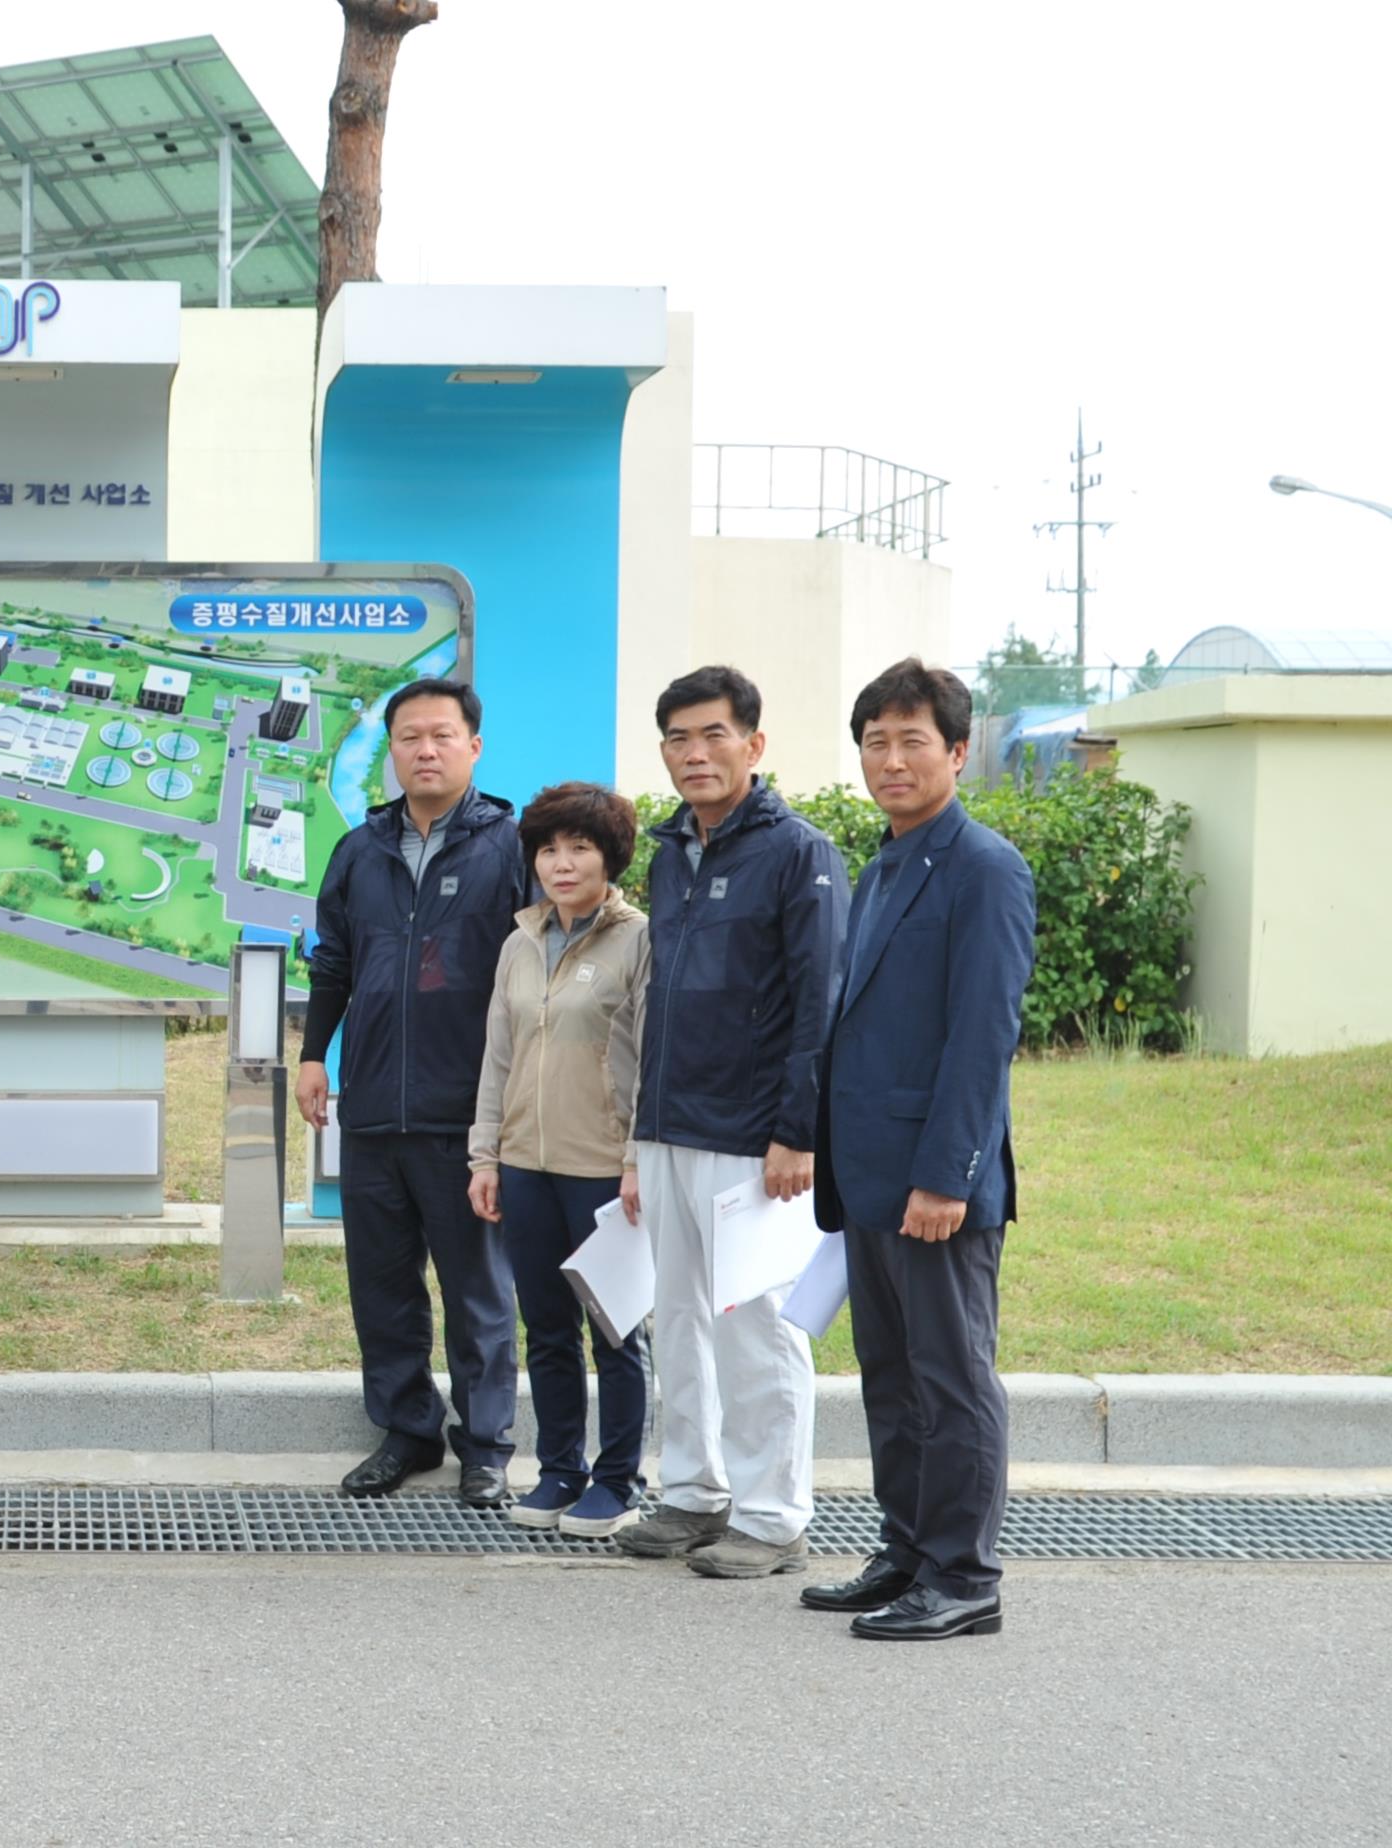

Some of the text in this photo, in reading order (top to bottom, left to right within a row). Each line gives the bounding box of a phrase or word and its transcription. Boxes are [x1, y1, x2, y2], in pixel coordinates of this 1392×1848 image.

[24, 483, 71, 505] 개선
[80, 483, 151, 505] 사업소
[192, 602, 410, 627] 증평수질개선사업소
